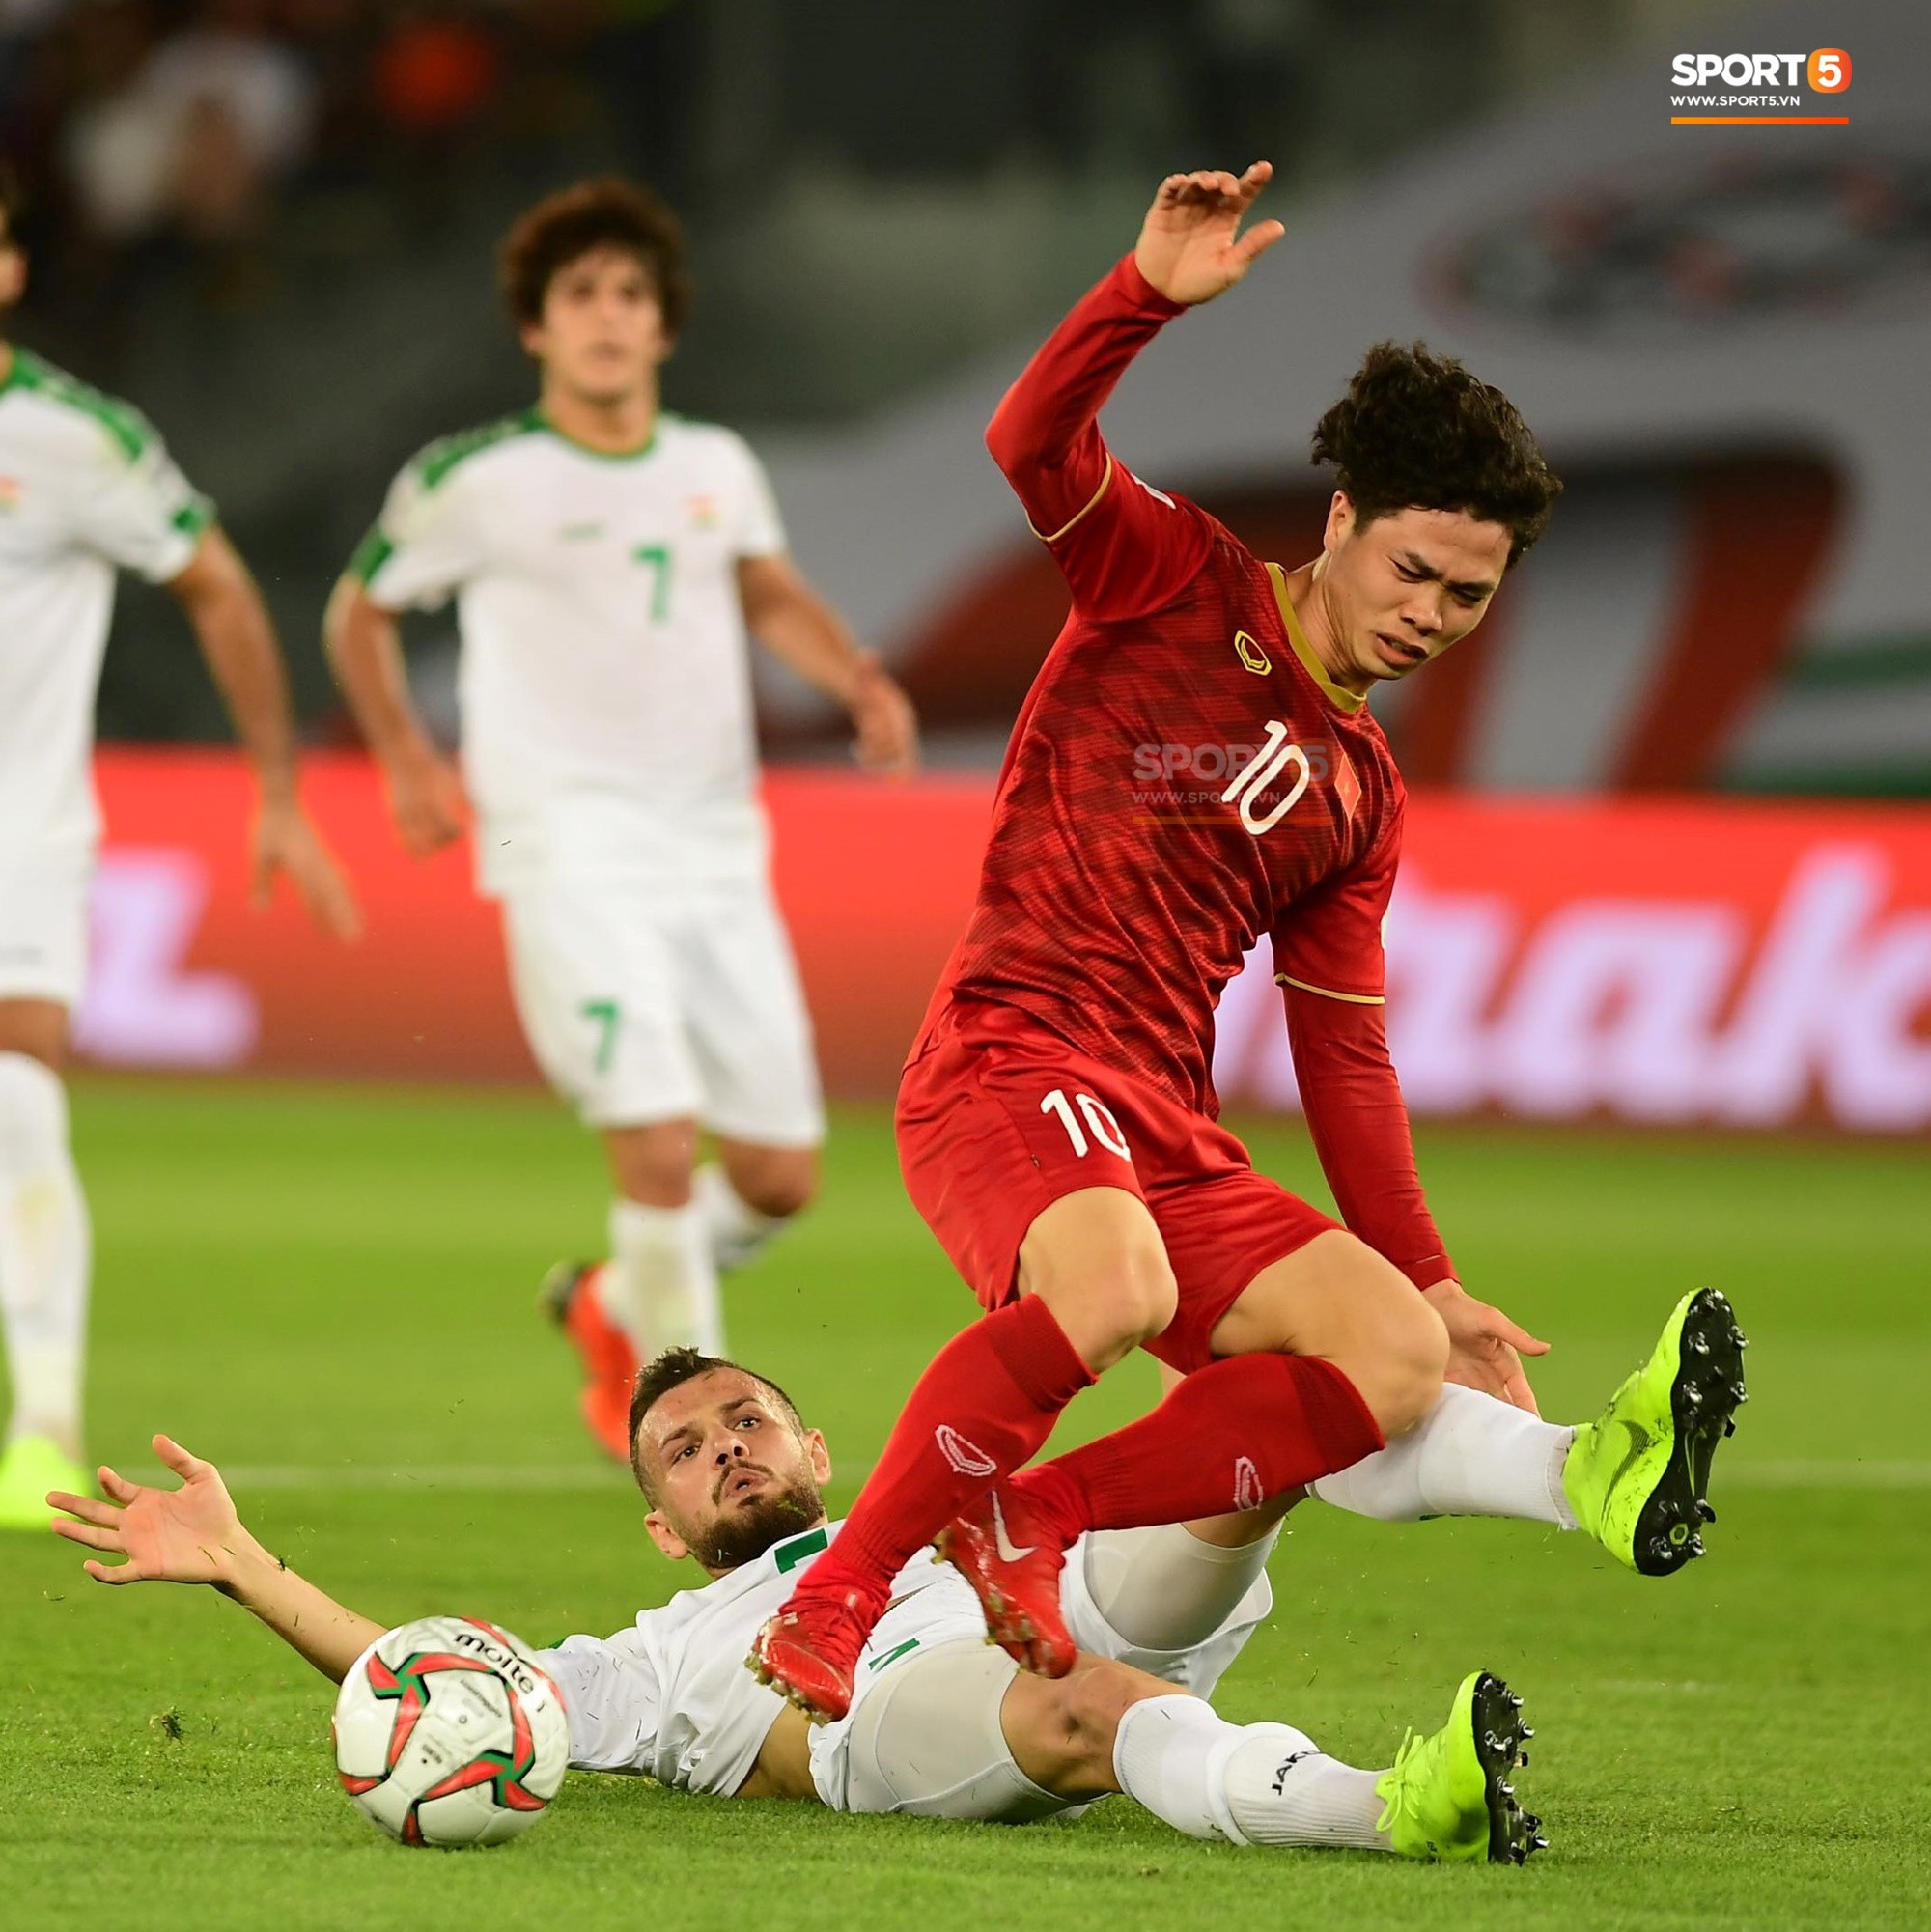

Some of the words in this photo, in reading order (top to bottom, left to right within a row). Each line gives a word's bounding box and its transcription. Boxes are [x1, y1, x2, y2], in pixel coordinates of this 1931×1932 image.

[631, 544, 670, 624] 7
[1220, 719, 1310, 835] 10
[579, 999, 621, 1075] 7
[1040, 1089, 1132, 1162] 10
